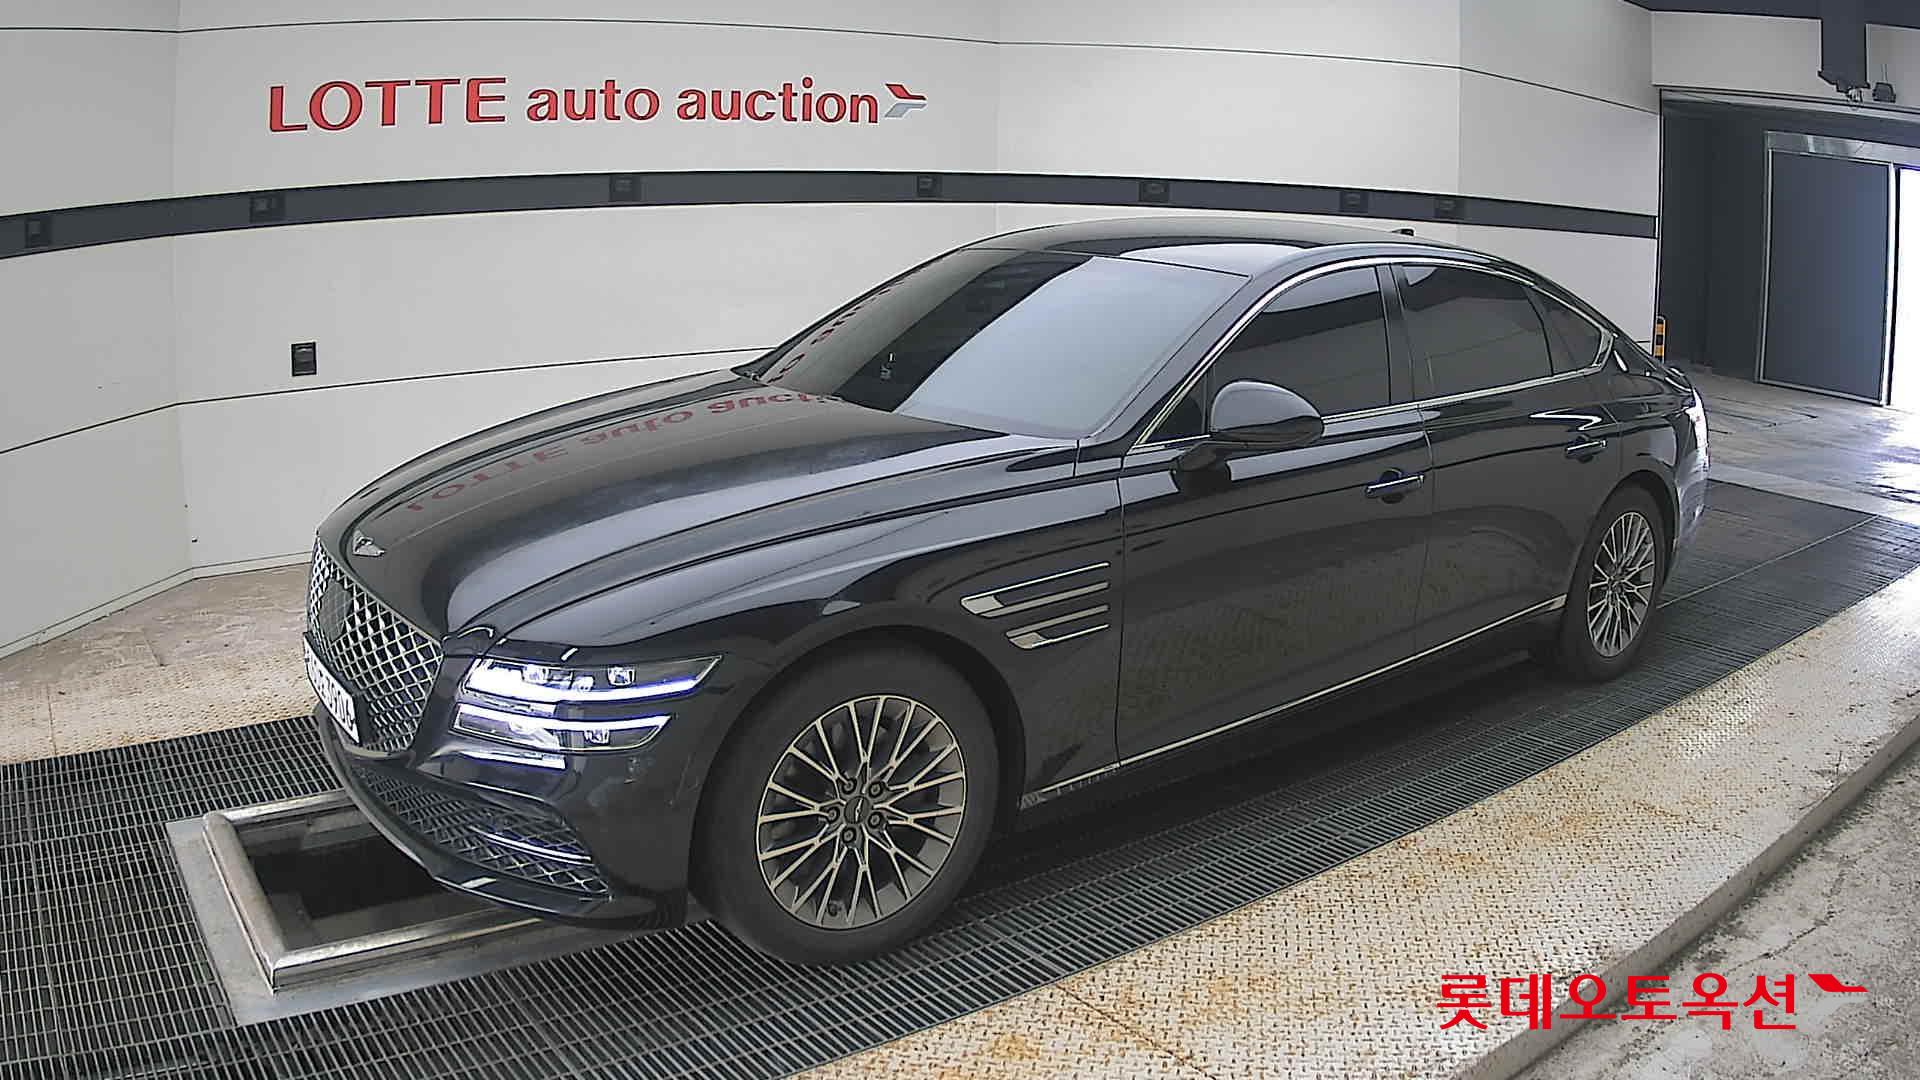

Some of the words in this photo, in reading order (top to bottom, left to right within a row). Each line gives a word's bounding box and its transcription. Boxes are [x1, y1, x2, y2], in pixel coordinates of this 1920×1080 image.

[269, 77, 506, 132] LOTTE
[527, 79, 660, 122] auto
[676, 76, 879, 124] auction
